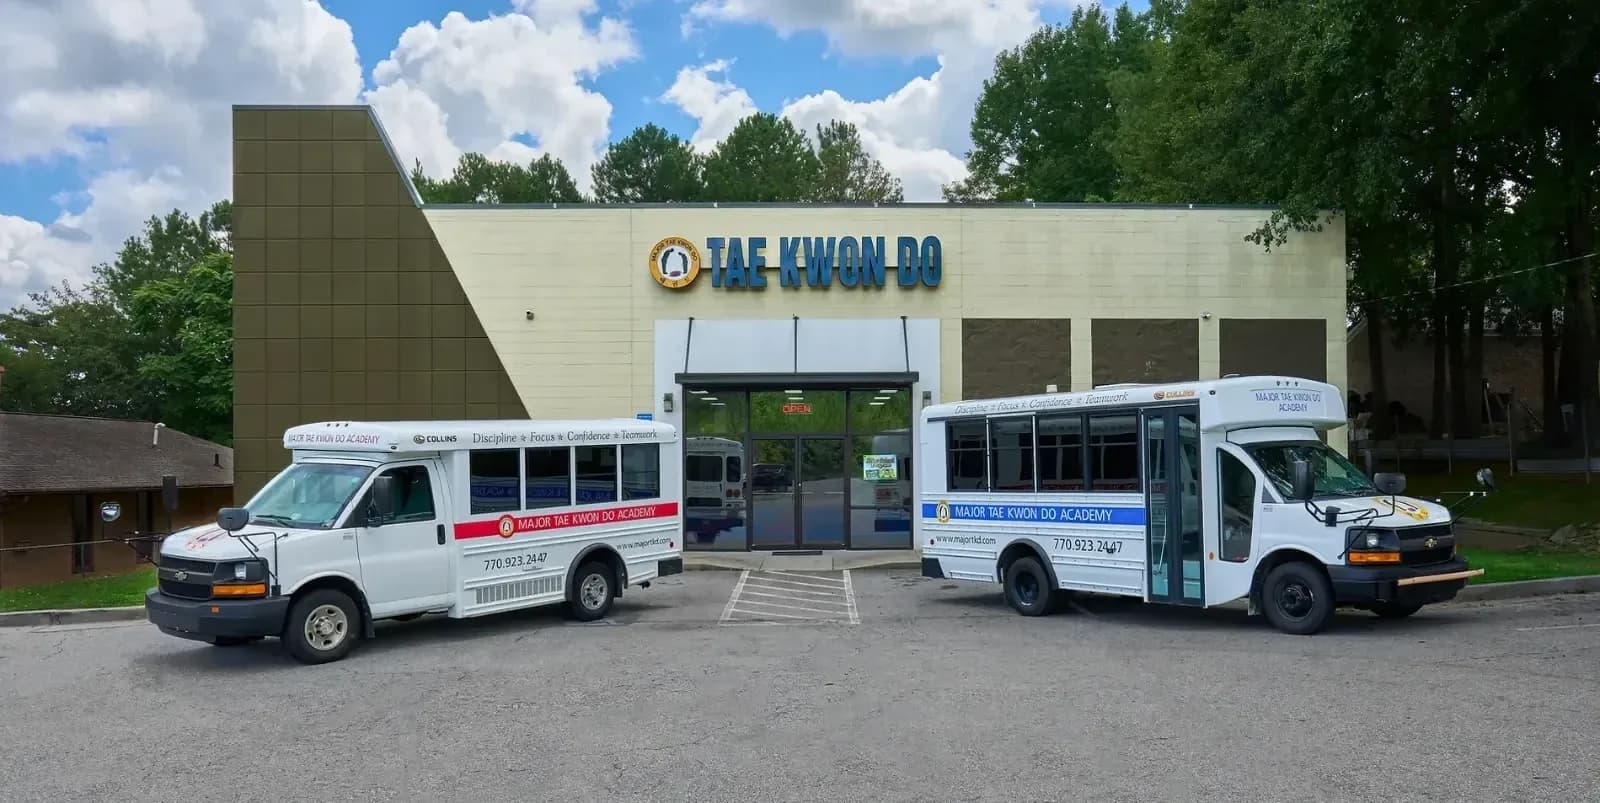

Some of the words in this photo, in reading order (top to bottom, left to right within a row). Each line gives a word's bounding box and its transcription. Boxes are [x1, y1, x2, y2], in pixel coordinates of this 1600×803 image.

[706, 236, 767, 288] TAE
[780, 236, 885, 288] KWON
[897, 236, 942, 287] DO
[954, 403, 988, 415] Discipline
[998, 401, 1019, 411] Focus
[1030, 397, 1072, 409] Confidence
[1085, 391, 1129, 405] Teamwork
[1256, 392, 1279, 401] MAJOR
[1281, 393, 1292, 401] TAE
[1293, 393, 1312, 401] KWON
[1313, 393, 1320, 402] DO
[783, 405, 810, 413] OPEN
[1279, 403, 1308, 412] ACADEMY
[288, 433, 304, 442] MAJOR
[305, 434, 315, 442] TAE
[316, 434, 334, 443] KWON
[335, 434, 345, 443] DO
[346, 434, 380, 444] ACADEMY
[473, 433, 517, 444] Discipline
[530, 432, 555, 442] Focus
[567, 430, 610, 442] Confidence
[622, 430, 657, 439] Teamwork
[518, 517, 551, 530] MAJOR
[554, 515, 569, 526] TAE
[573, 512, 600, 524] KWON
[602, 511, 616, 521] DO
[617, 507, 656, 520] ACADEMY
[955, 506, 986, 518] MAJOR
[988, 507, 1004, 518] TAE
[1007, 507, 1038, 519] KWON
[1041, 508, 1056, 520] DO
[1060, 508, 1113, 521] ACADEMY
[616, 537, 671, 549] www.majortkd.com
[936, 535, 996, 545] www.majortkd.com
[1053, 538, 1123, 553] 770.923.2447
[484, 552, 548, 571] 770.923.2447
